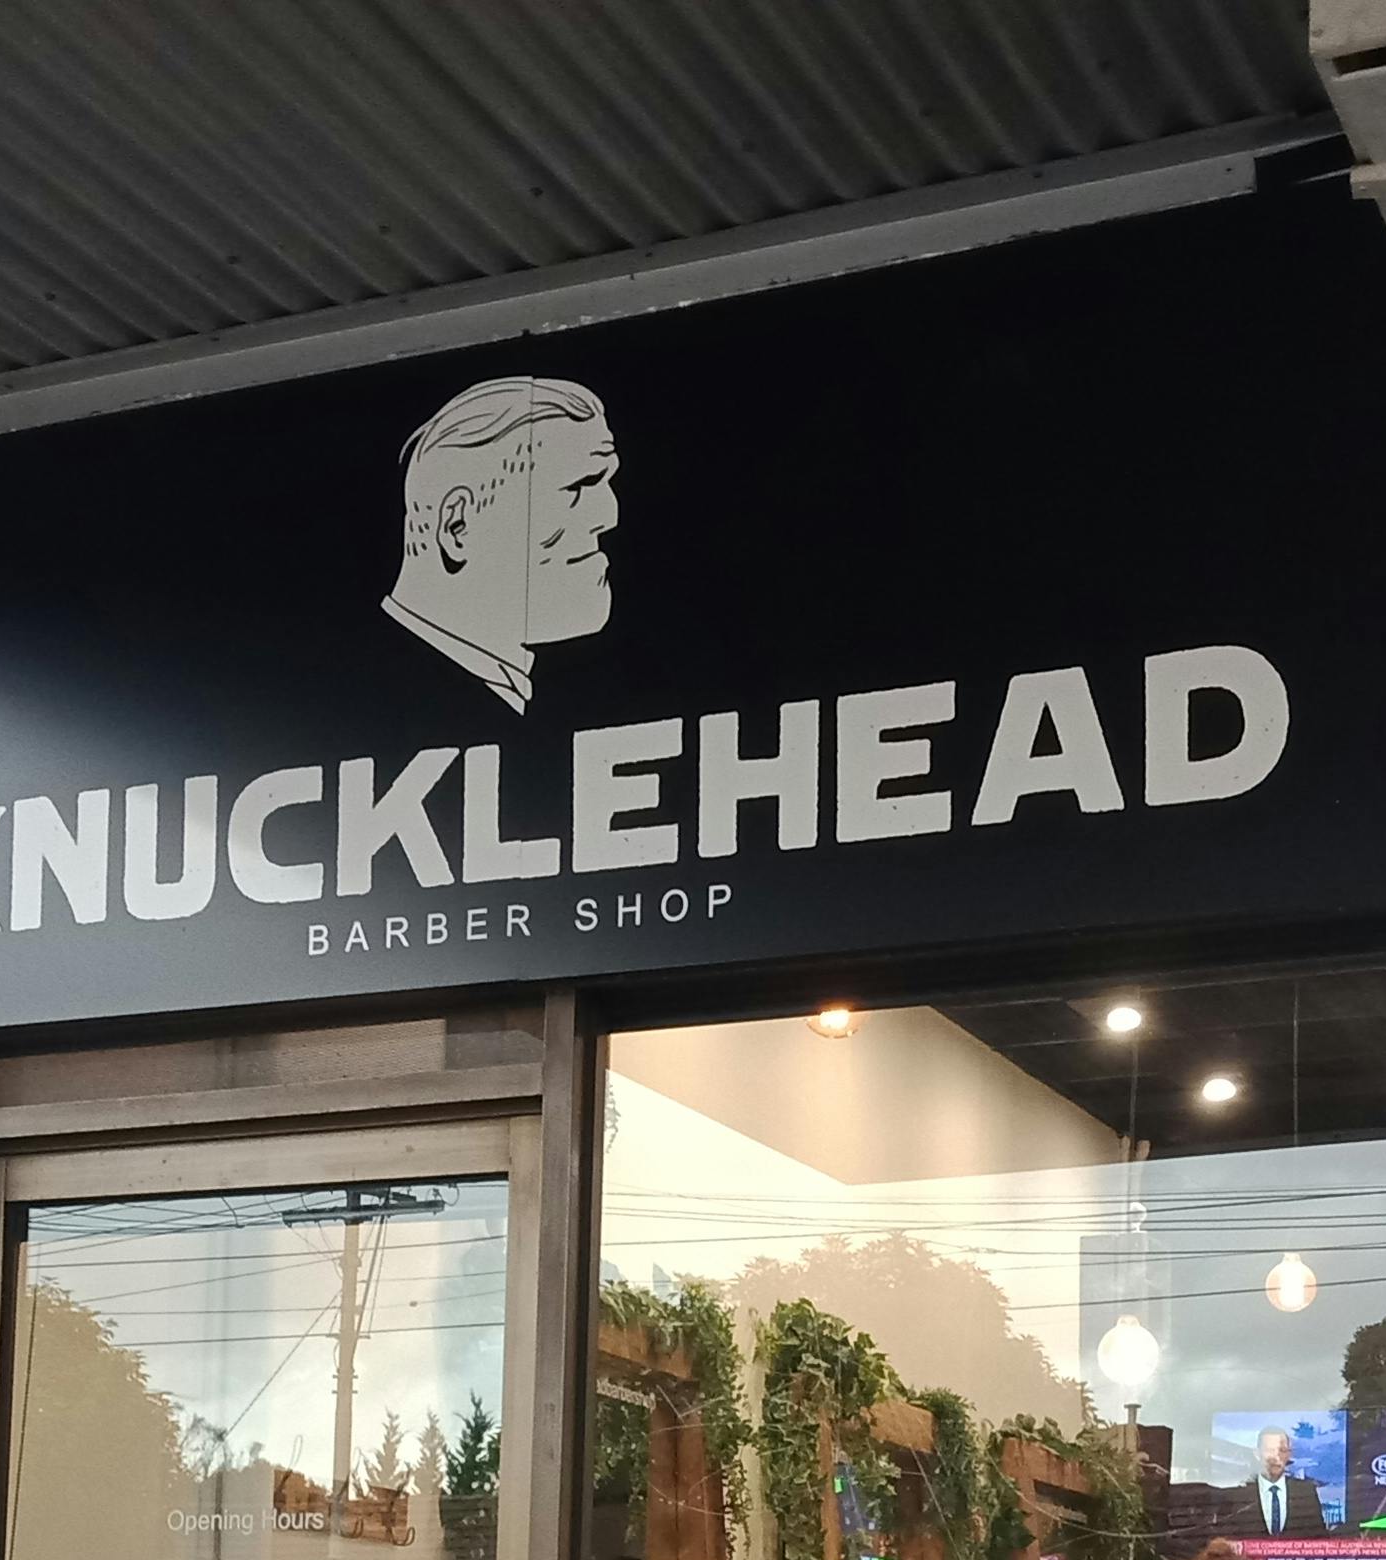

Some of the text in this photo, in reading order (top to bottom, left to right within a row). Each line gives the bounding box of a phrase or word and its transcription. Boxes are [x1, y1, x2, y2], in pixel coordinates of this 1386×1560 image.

[307, 884, 736, 956] BARBER SHOP
[167, 1509, 325, 1533] Opening Hours
